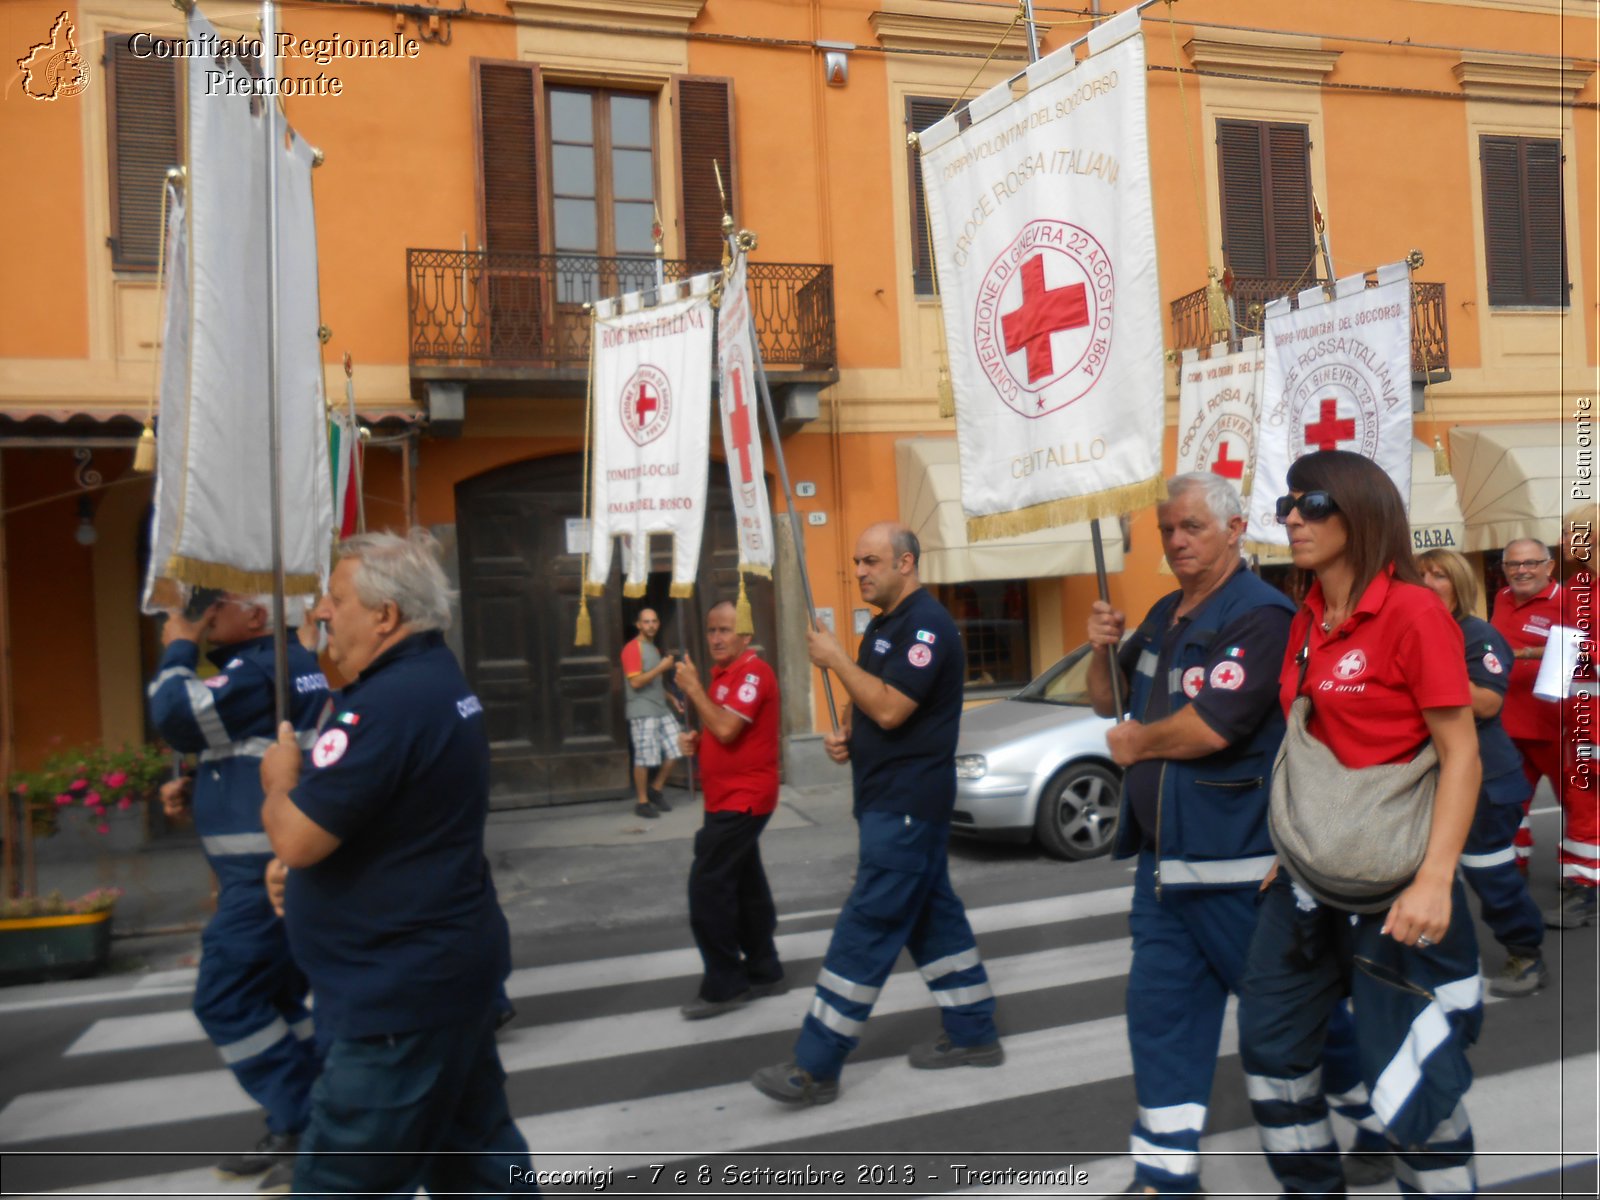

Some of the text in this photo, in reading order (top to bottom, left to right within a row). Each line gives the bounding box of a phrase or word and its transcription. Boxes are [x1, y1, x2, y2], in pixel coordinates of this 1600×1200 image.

[1030, 107, 1054, 129] DEL
[953, 193, 995, 268] CROCE
[992, 152, 1046, 206] ROSSA
[976, 225, 1113, 402] CONVENZIONE DI GINEVRA 22 AGOSTO 1864
[1338, 316, 1352, 331] DEL
[1354, 303, 1401, 327] SOCCORSO
[1269, 366, 1299, 427] CROCE
[1297, 337, 1346, 371] ROSSA
[1347, 338, 1400, 412] ITALIANA
[1363, 410, 1377, 459] AGOST
[659, 496, 693, 512] BOSCO
[1413, 528, 1456, 548] SARA
[1318, 679, 1366, 692] 15 anni
